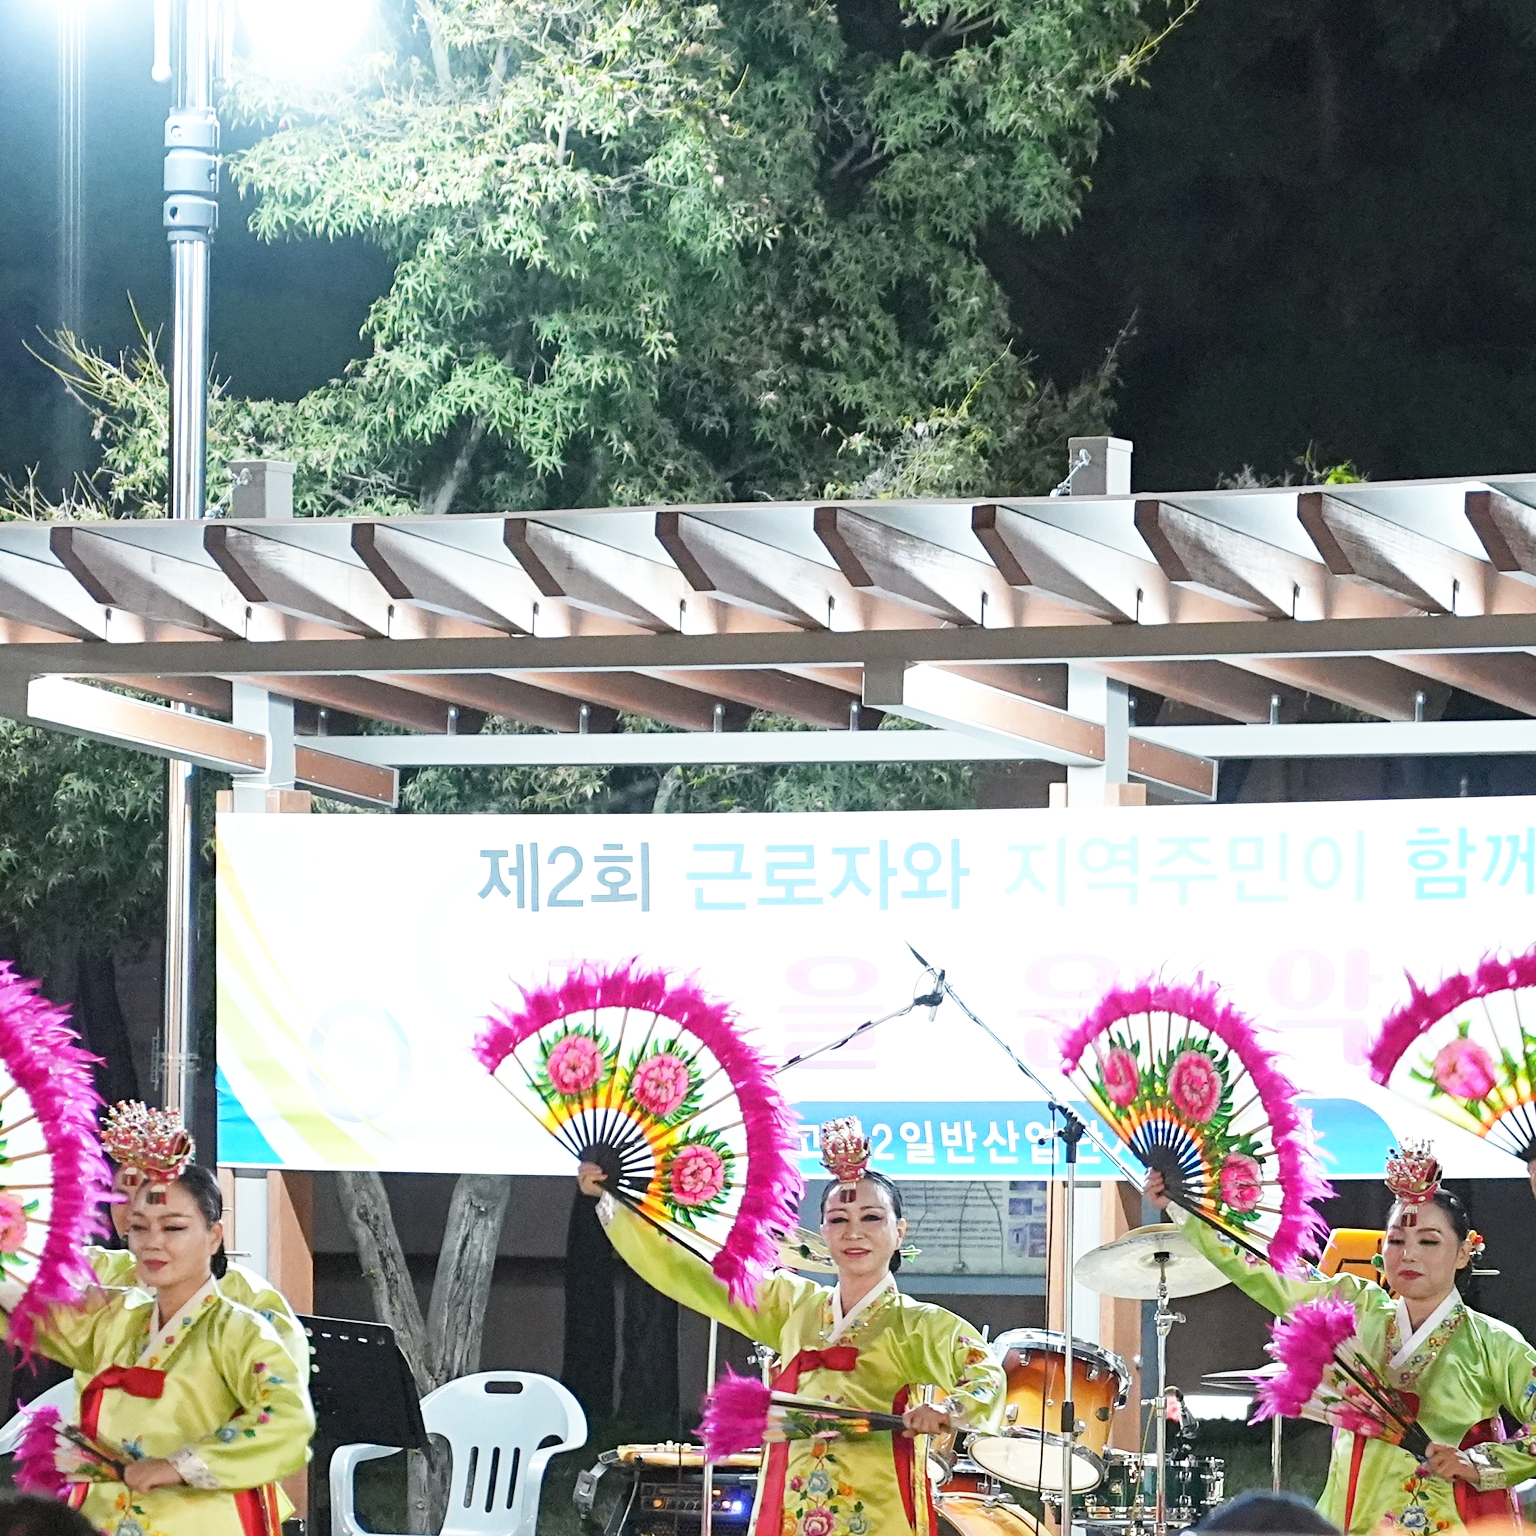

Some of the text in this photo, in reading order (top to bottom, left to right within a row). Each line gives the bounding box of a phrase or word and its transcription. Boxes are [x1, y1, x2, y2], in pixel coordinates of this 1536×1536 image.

[477, 842, 651, 912] 제2회
[685, 838, 970, 911] 근로자와
[1003, 830, 1366, 906] 지역주민이
